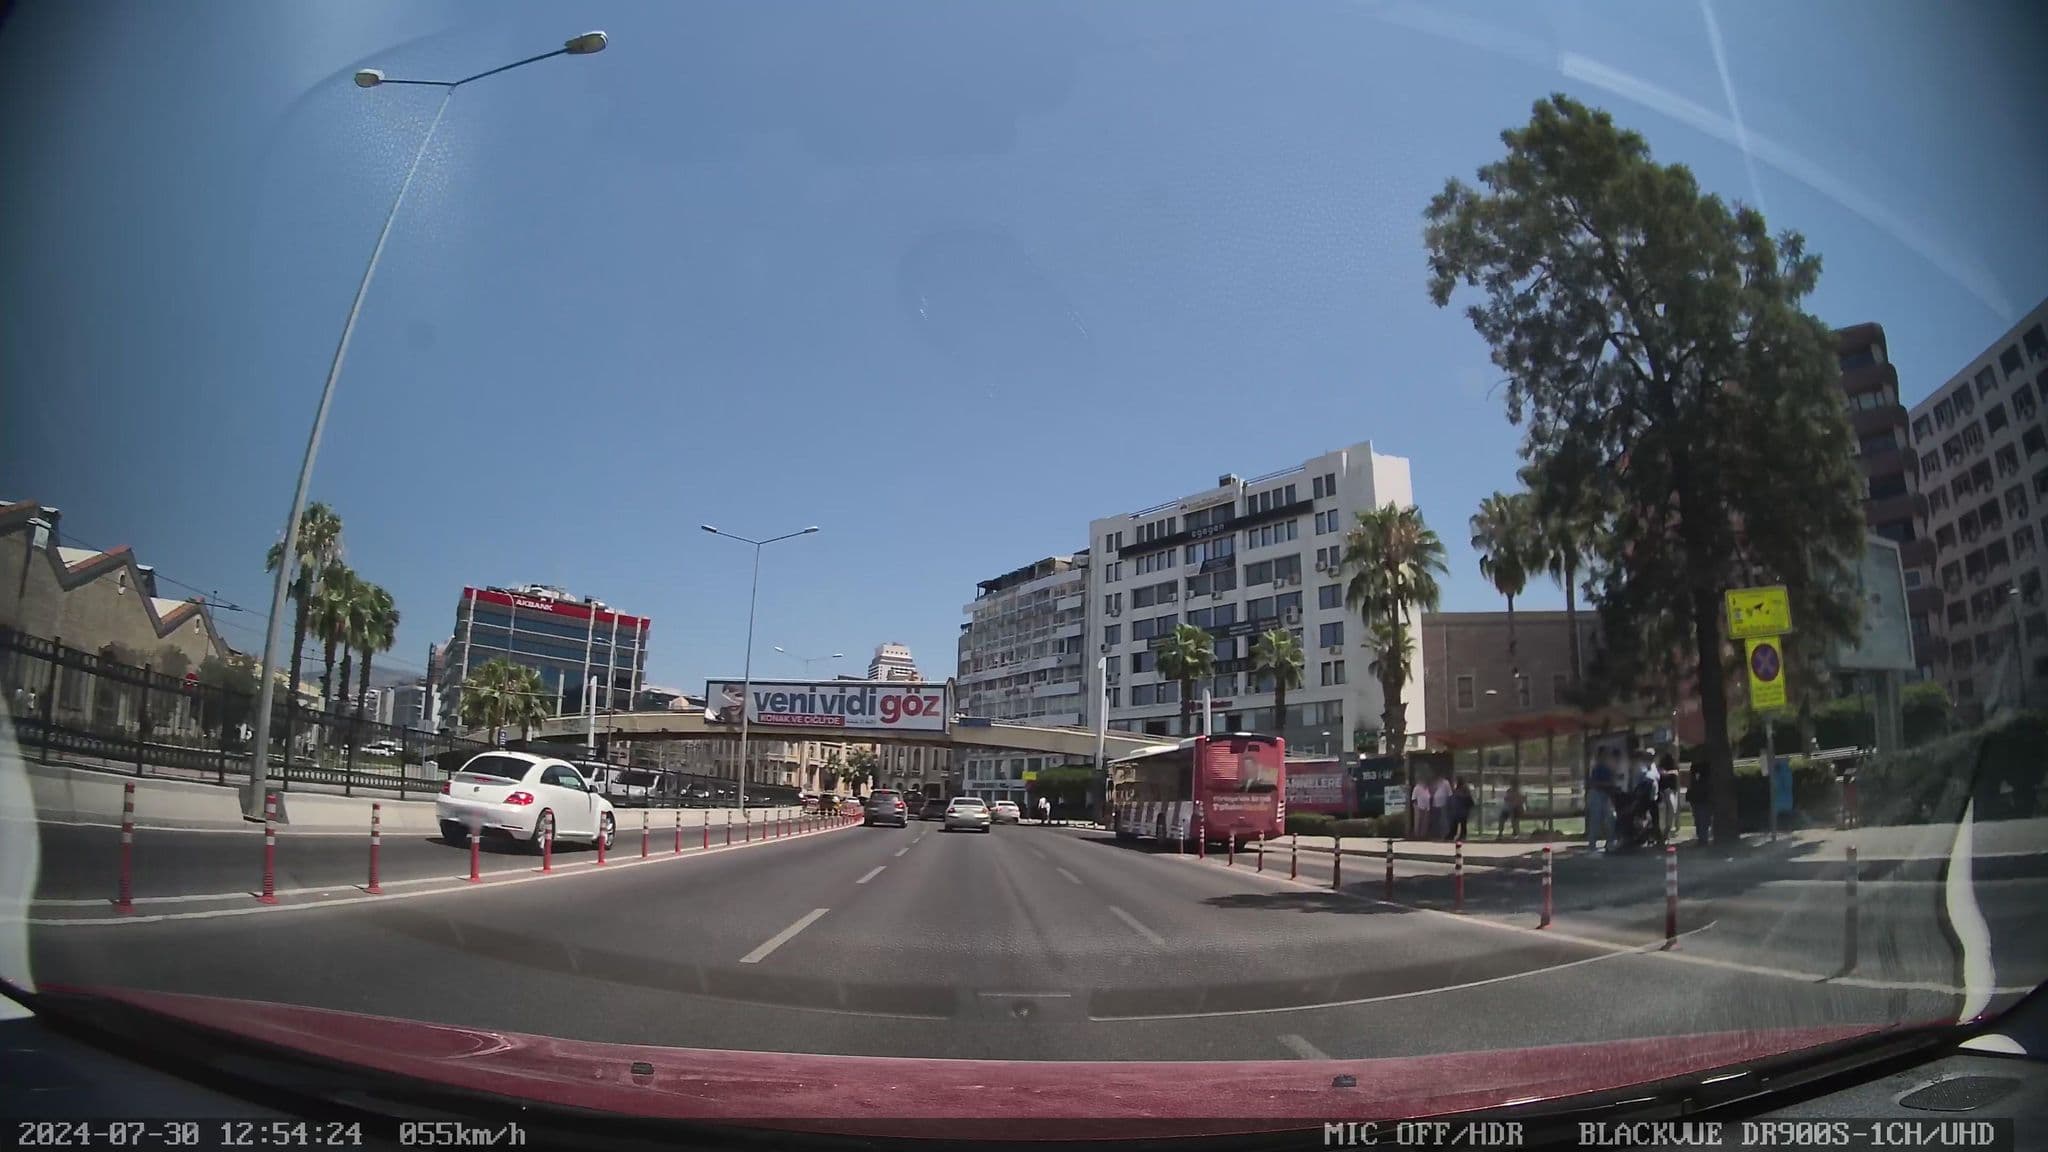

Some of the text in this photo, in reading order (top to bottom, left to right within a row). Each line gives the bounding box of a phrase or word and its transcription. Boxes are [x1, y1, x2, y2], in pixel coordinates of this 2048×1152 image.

[516, 599, 553, 611] AKBANK
[753, 687, 939, 723] veni vidi göz
